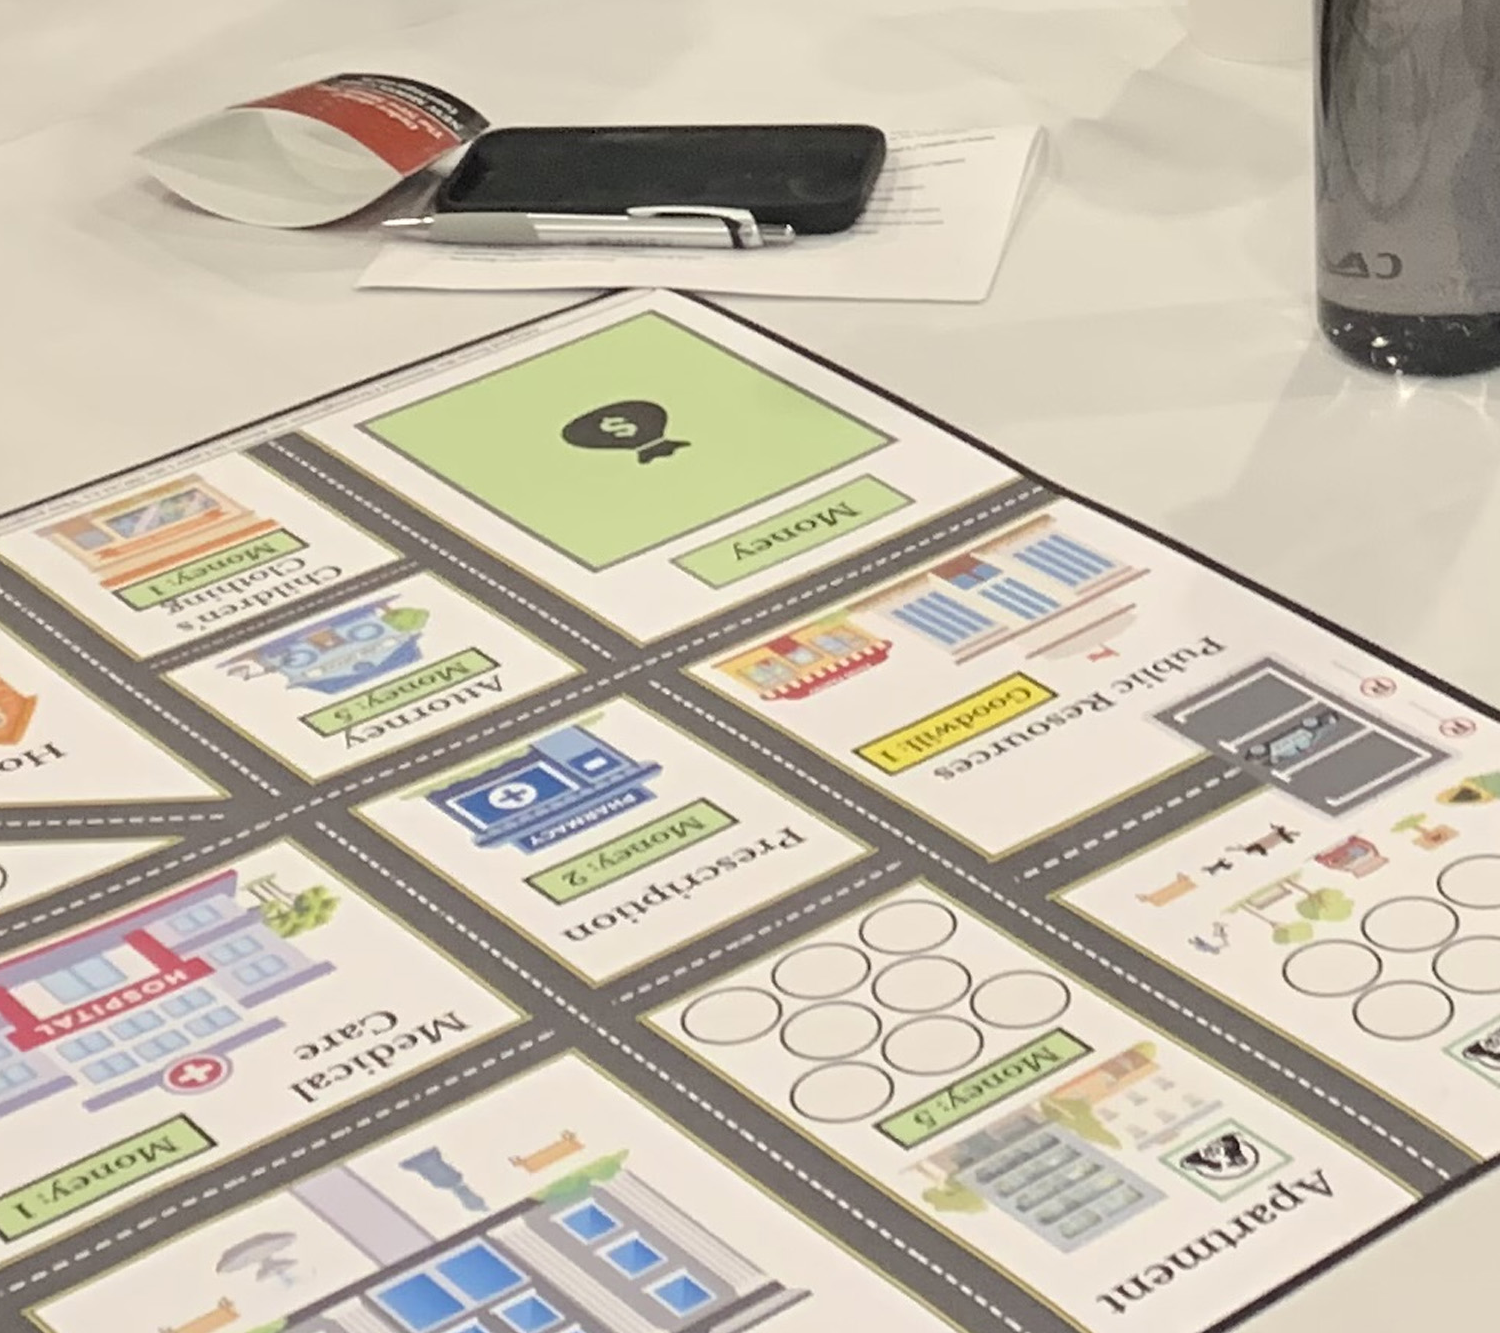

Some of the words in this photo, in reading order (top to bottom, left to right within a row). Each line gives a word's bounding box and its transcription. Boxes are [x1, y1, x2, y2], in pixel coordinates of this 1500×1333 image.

[730, 498, 862, 562] Money
[147, 584, 161, 596] 1
[159, 556, 306, 614] Clothing
[166, 540, 280, 591] Money:
[175, 563, 344, 633] Children's
[357, 661, 468, 711] Money:
[1113, 634, 1227, 702] Public
[332, 706, 352, 723] 5
[342, 676, 504, 749] Attorney
[898, 684, 1035, 755] Goodwill:
[932, 690, 1115, 782] Resources
[877, 746, 899, 764] 1
[525, 792, 640, 848] PHARMACY
[588, 814, 707, 870] Money:
[560, 868, 587, 890] 2
[562, 826, 808, 943] Prescription
[34, 967, 190, 1039] HOSPITAL
[292, 1011, 472, 1103] Medical
[296, 1009, 400, 1061] Care
[940, 1047, 1062, 1115] Money:
[914, 1112, 940, 1132] 5
[37, 1135, 180, 1203] Money:
[10, 1201, 30, 1222] 1
[1097, 1167, 1338, 1317] Apartment
